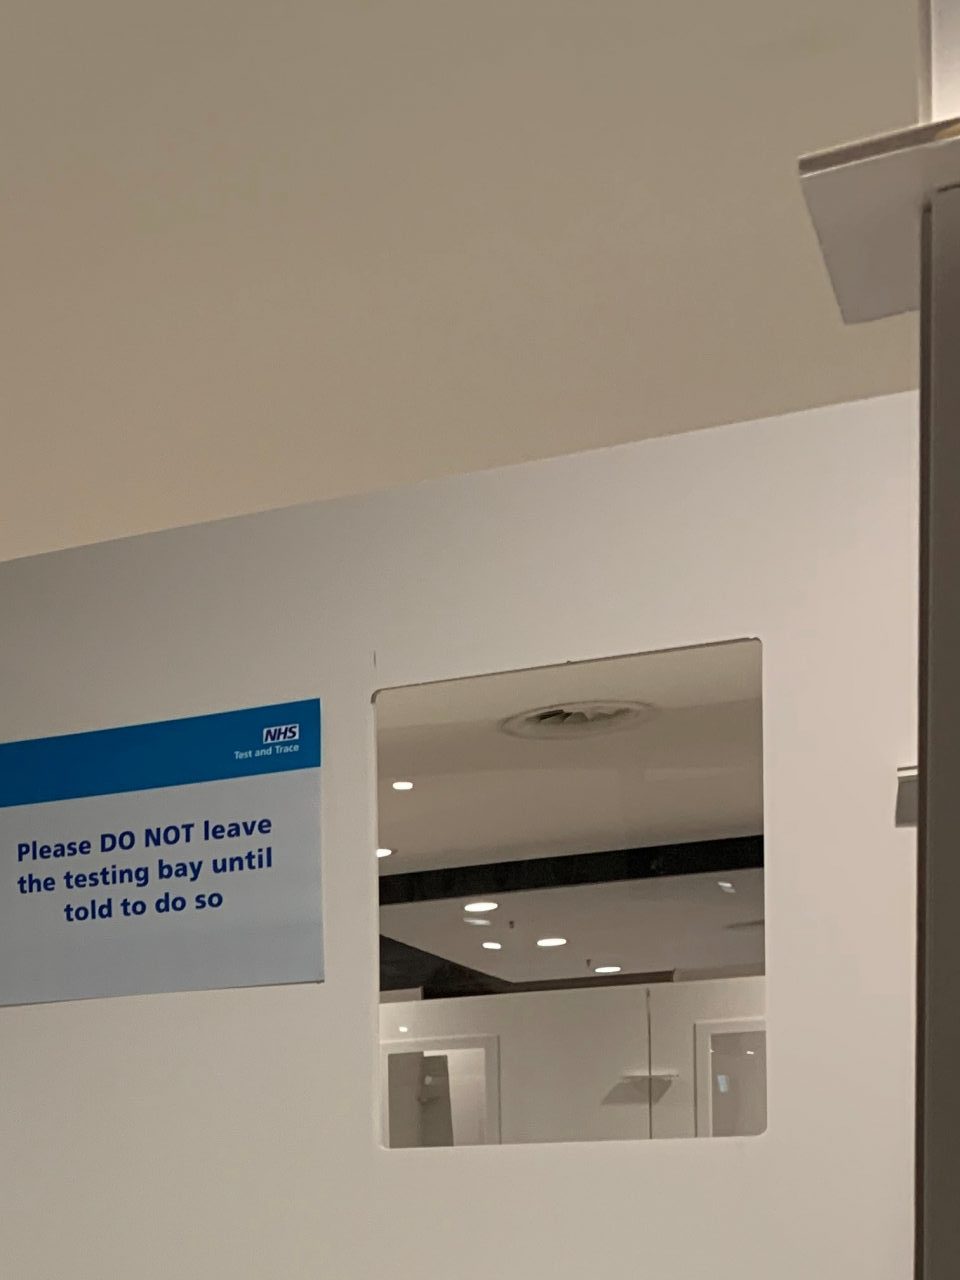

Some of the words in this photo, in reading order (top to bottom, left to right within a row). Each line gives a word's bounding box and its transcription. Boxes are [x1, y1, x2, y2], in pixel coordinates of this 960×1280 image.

[263, 725, 298, 743] NHS
[235, 750, 252, 760] Test
[255, 746, 272, 757] and
[275, 743, 299, 754] Trace
[17, 839, 91, 862] Please
[100, 830, 136, 853] DO
[144, 823, 194, 848] NOT
[204, 818, 272, 841] leave
[17, 873, 56, 894] the
[64, 864, 149, 889] testing
[158, 859, 203, 882] bay
[212, 847, 273, 875] until
[64, 898, 113, 922] told
[121, 898, 147, 917] to
[155, 892, 187, 914] do
[195, 890, 224, 909] so
